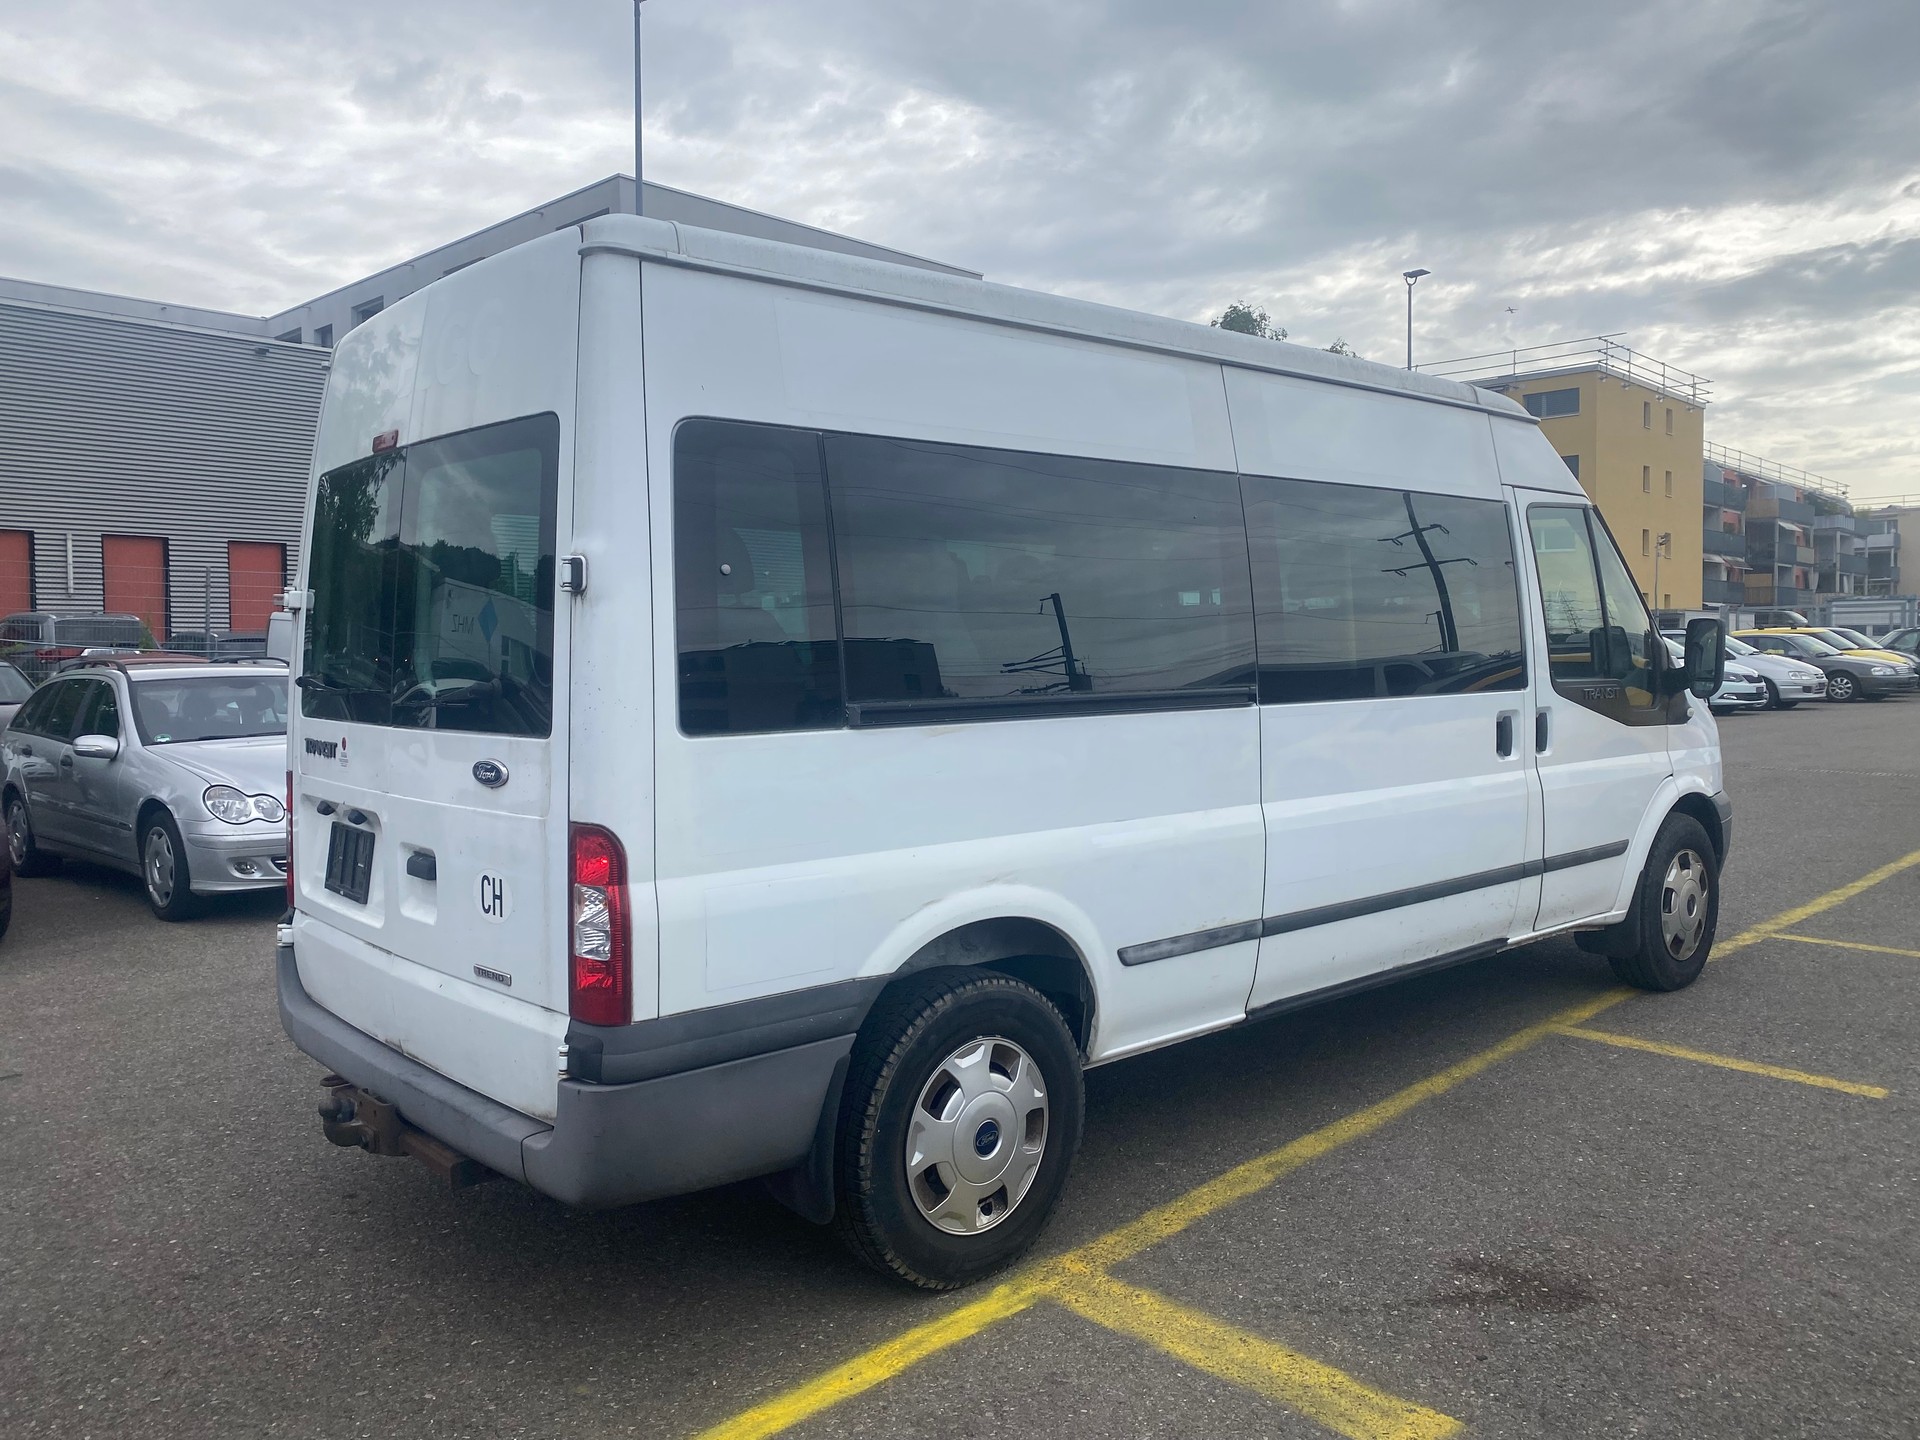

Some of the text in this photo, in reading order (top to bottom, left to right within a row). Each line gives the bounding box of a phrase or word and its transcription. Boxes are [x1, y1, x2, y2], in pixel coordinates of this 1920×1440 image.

[304, 737, 338, 759] TRANSIT
[477, 764, 497, 780] Ford
[481, 874, 503, 918] CH
[476, 967, 504, 982] TREND
